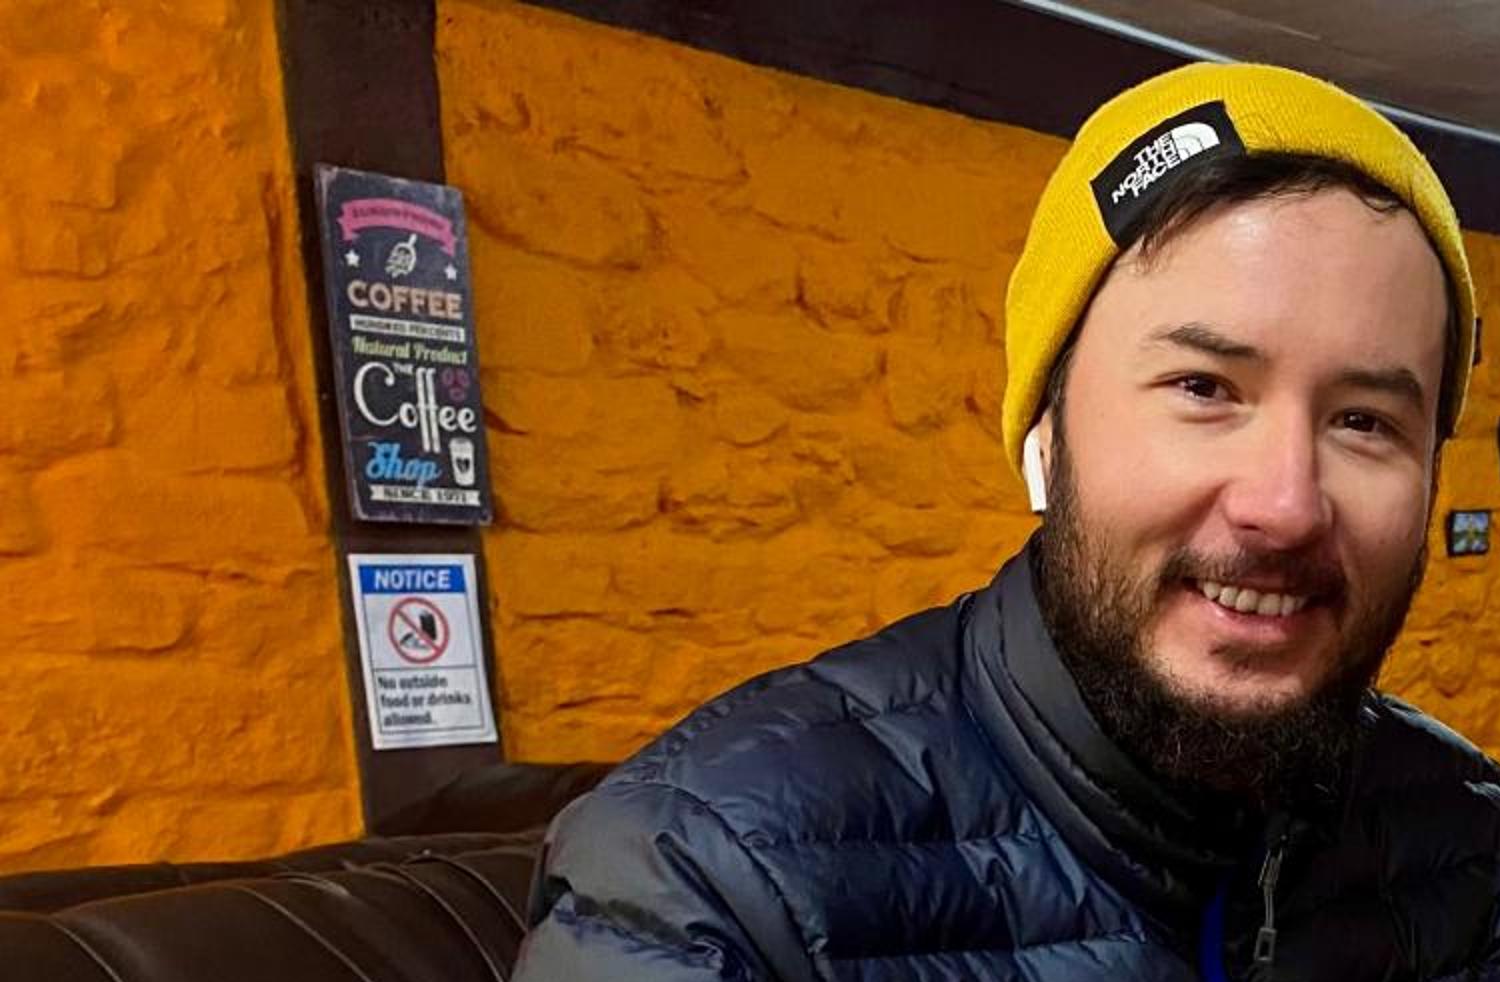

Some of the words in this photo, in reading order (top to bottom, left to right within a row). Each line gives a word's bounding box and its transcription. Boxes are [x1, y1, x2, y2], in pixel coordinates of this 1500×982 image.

[1133, 131, 1174, 165] THE
[1111, 143, 1178, 204] NORTH
[1131, 156, 1181, 198] FACE
[347, 280, 463, 320] COFFEE
[352, 336, 410, 358] Natural
[412, 343, 467, 364] Product
[354, 361, 477, 453] Coffee
[366, 442, 442, 491] Shop
[374, 569, 452, 590] NOTICE
[378, 676, 396, 688] No
[399, 674, 448, 689] outside
[381, 693, 409, 707] food
[412, 695, 424, 707] or
[426, 690, 472, 706] drinks
